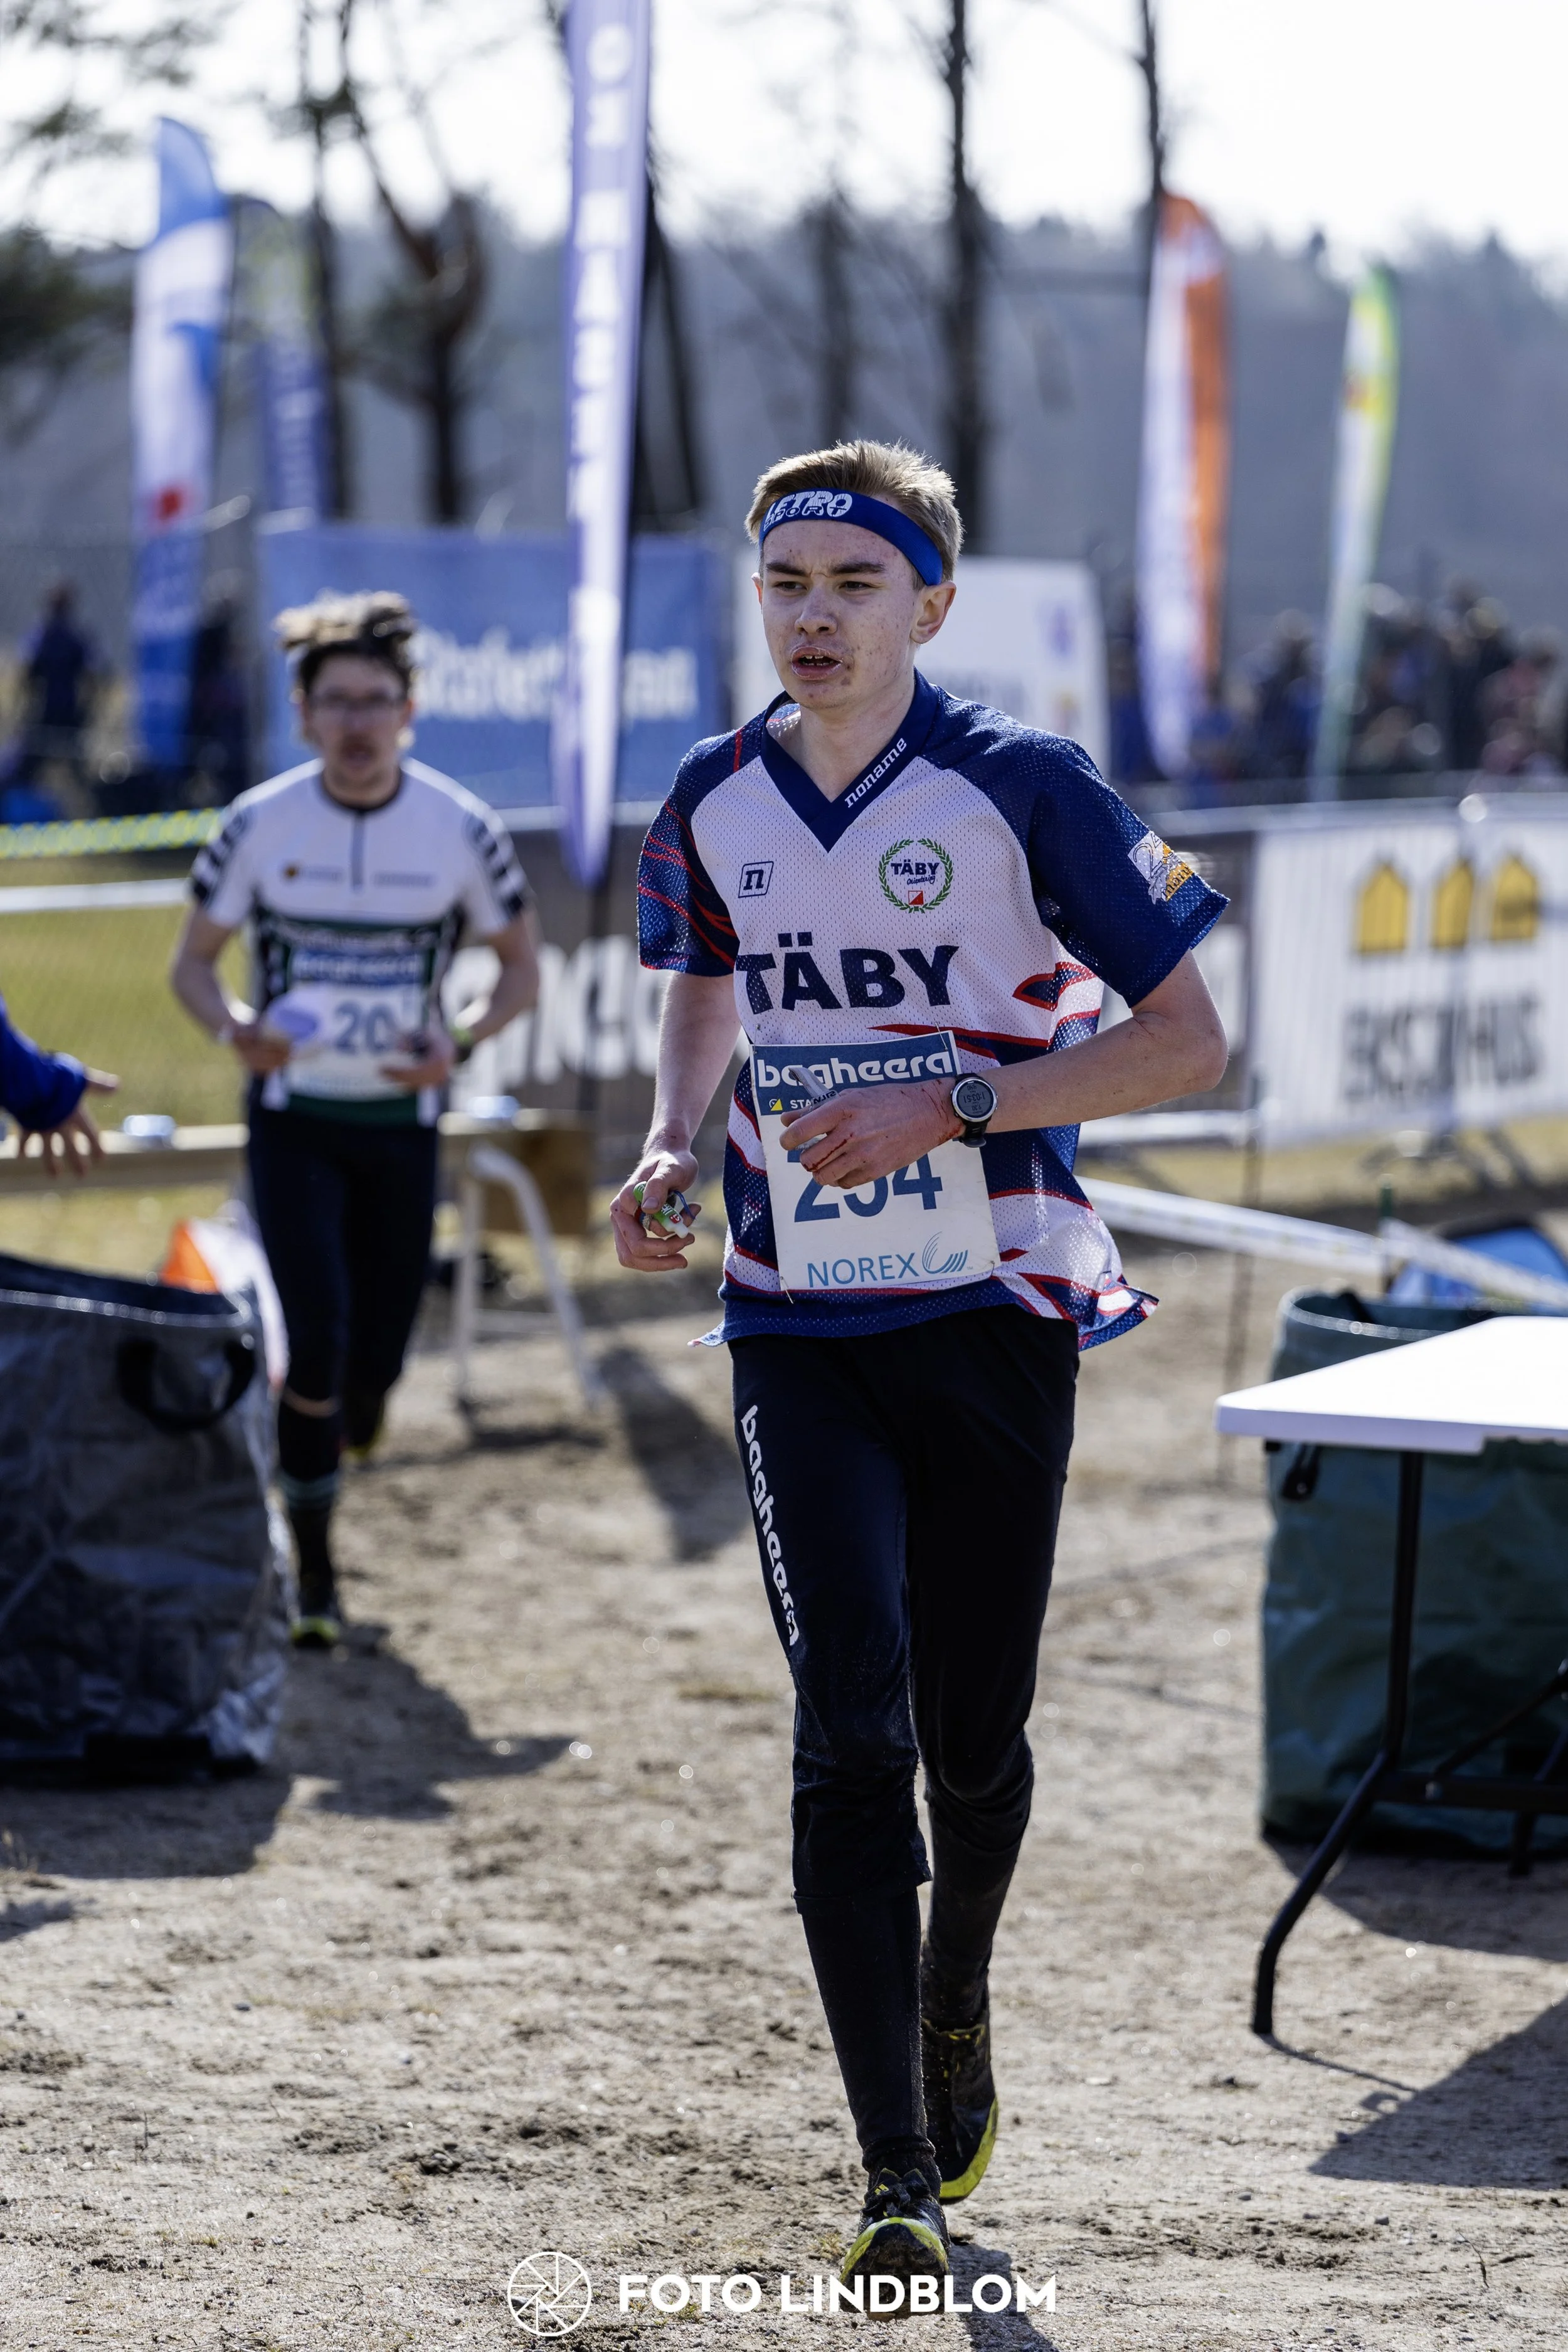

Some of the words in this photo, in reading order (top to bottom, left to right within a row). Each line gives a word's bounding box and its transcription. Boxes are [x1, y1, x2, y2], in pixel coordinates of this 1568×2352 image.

[844, 738, 907, 808] noname
[890, 859, 940, 875] TÄBY
[736, 931, 960, 1015] TÄBY
[757, 1051, 953, 1090] bagheera
[807, 1252, 920, 1288] NOREX
[741, 1405, 800, 1646] bagheera
